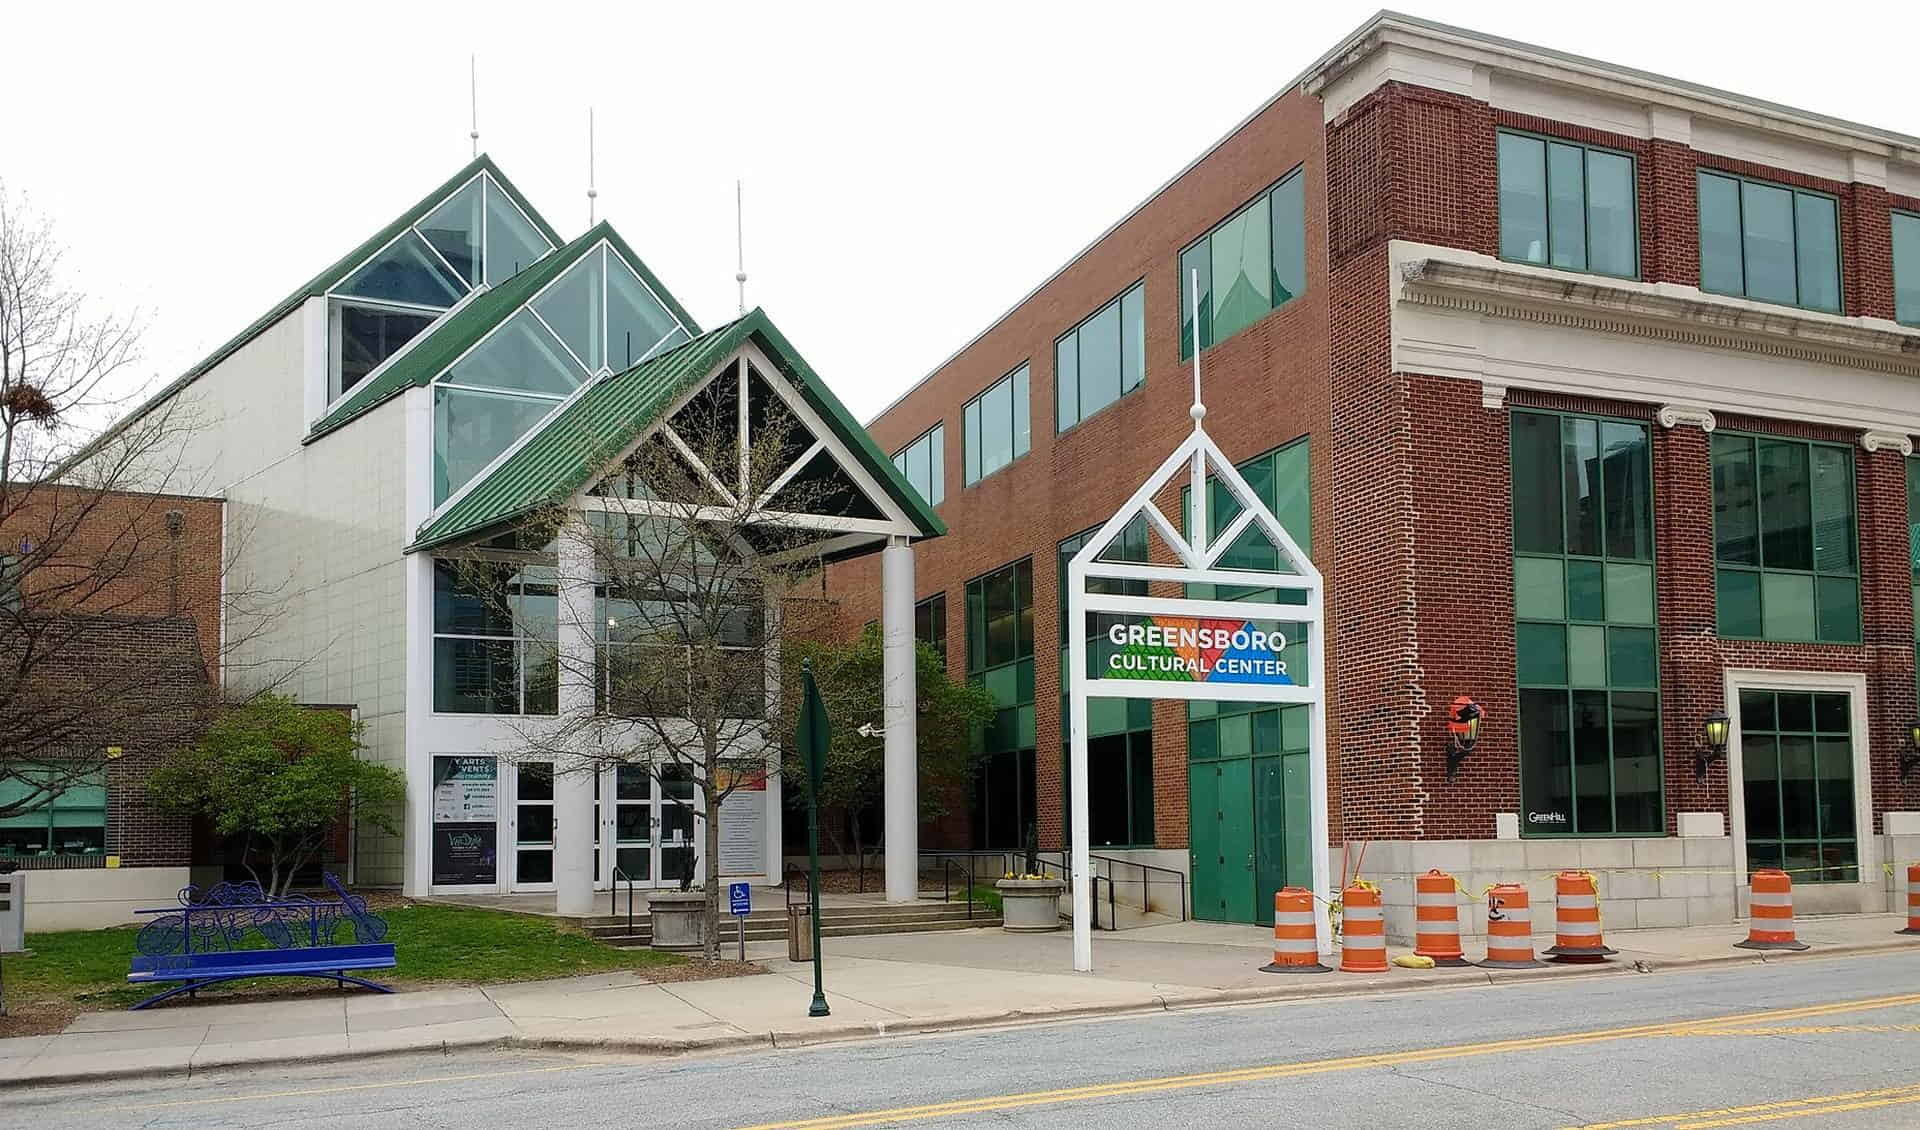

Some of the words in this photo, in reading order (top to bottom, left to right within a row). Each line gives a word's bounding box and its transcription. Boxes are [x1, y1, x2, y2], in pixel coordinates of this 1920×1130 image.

[1109, 623, 1287, 652] GREENSBORO
[1109, 654, 1210, 673] CULTURAL
[1215, 658, 1287, 675] CENTER
[459, 765, 490, 773] VENTS
